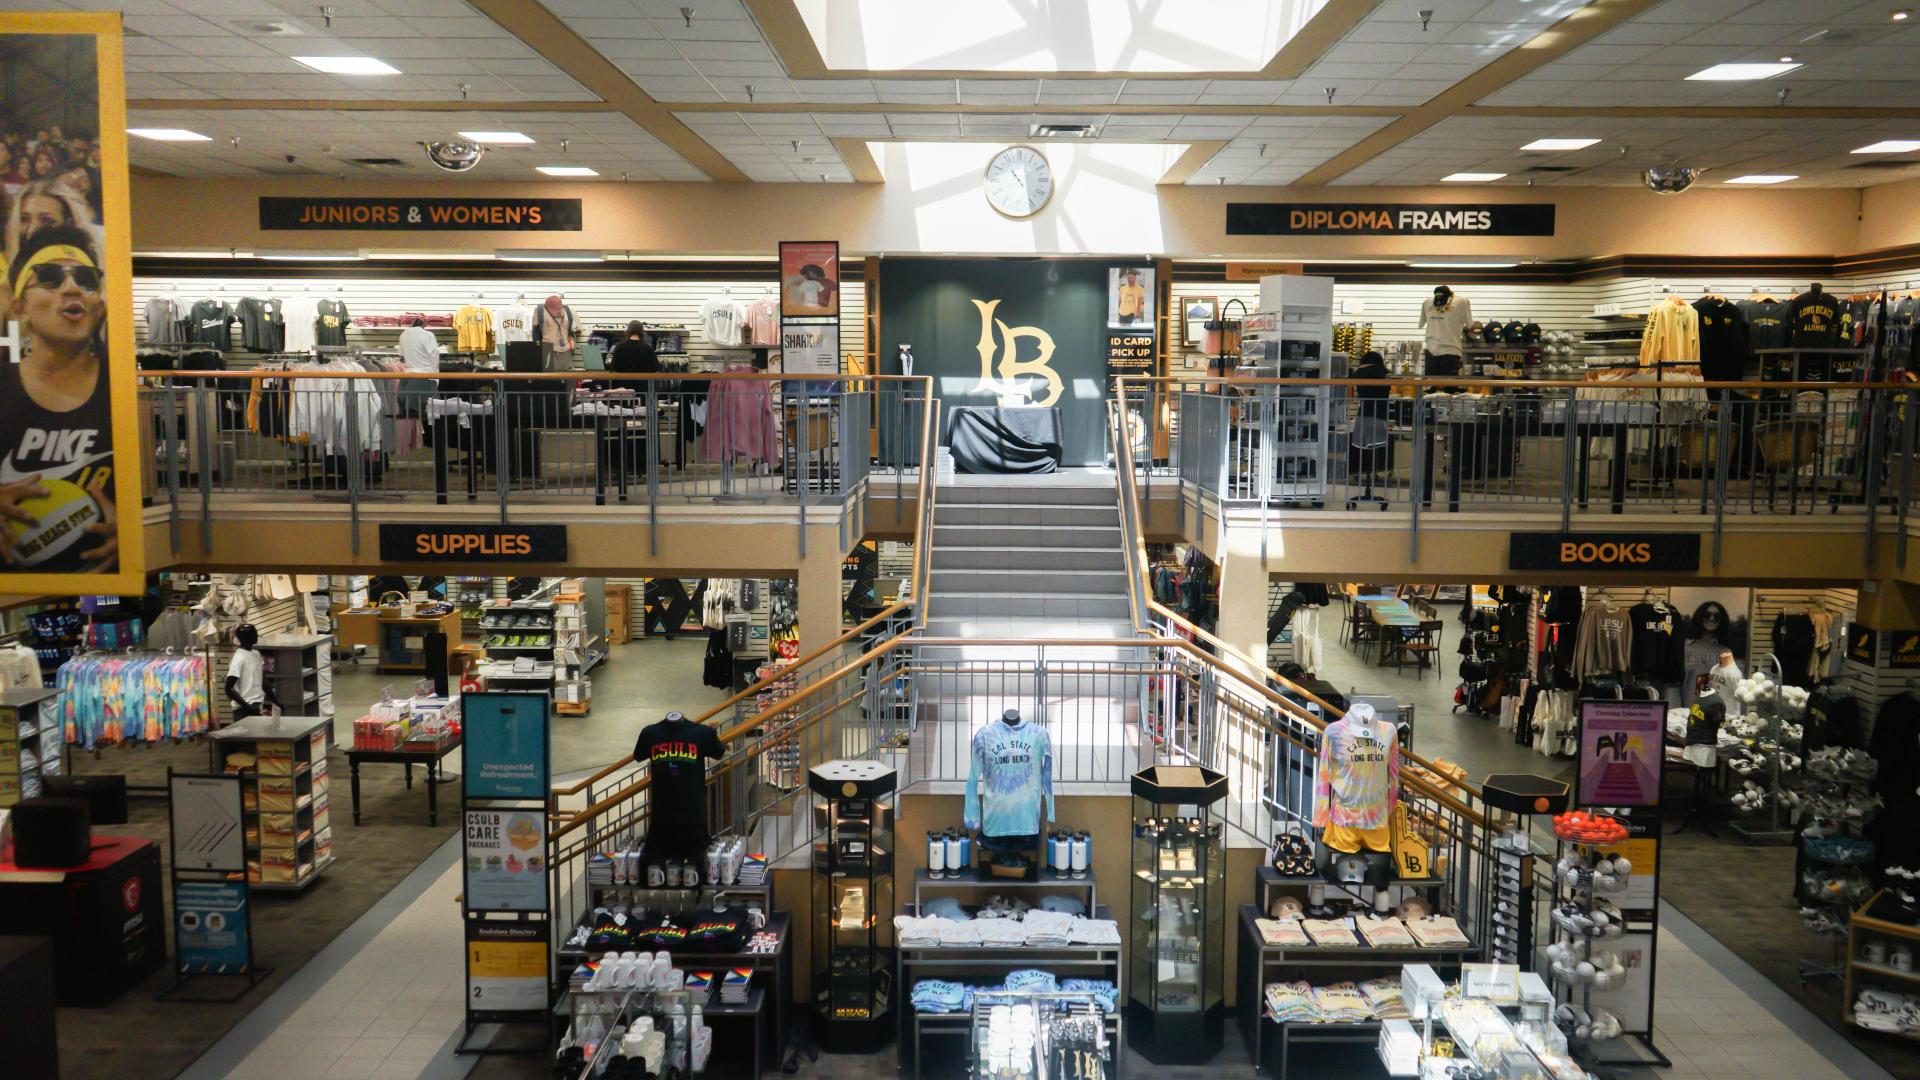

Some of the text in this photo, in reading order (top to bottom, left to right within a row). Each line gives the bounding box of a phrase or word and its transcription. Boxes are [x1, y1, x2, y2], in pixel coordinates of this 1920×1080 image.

[299, 206, 543, 224] JUNIORS & WOMEN'S
[1290, 211, 1492, 230] DIPLOMA FRAMES
[1803, 324, 1827, 333] ALUMNI
[1110, 338, 1151, 346] ID CARD
[1112, 349, 1150, 357] PICK UP
[16, 427, 99, 462] PIKE
[416, 534, 531, 555] SUPPLIES
[1560, 542, 1652, 563] BOOKS
[780, 641, 799, 656] ty
[651, 740, 698, 760] CSULB
[992, 741, 1032, 755] CAL STATE
[1365, 738, 1385, 752] STATE
[995, 755, 1030, 764] LONG BEACH
[1351, 754, 1385, 762] LONG BEACH
[483, 763, 534, 771] Unexpected
[480, 771, 537, 779] Refreshment.
[468, 814, 500, 825] CSULB
[468, 827, 500, 839] CARE
[1403, 851, 1423, 873] LB
[479, 928, 537, 936] Bookstore Directory
[474, 950, 480, 962] 1
[474, 986, 482, 998] 2
